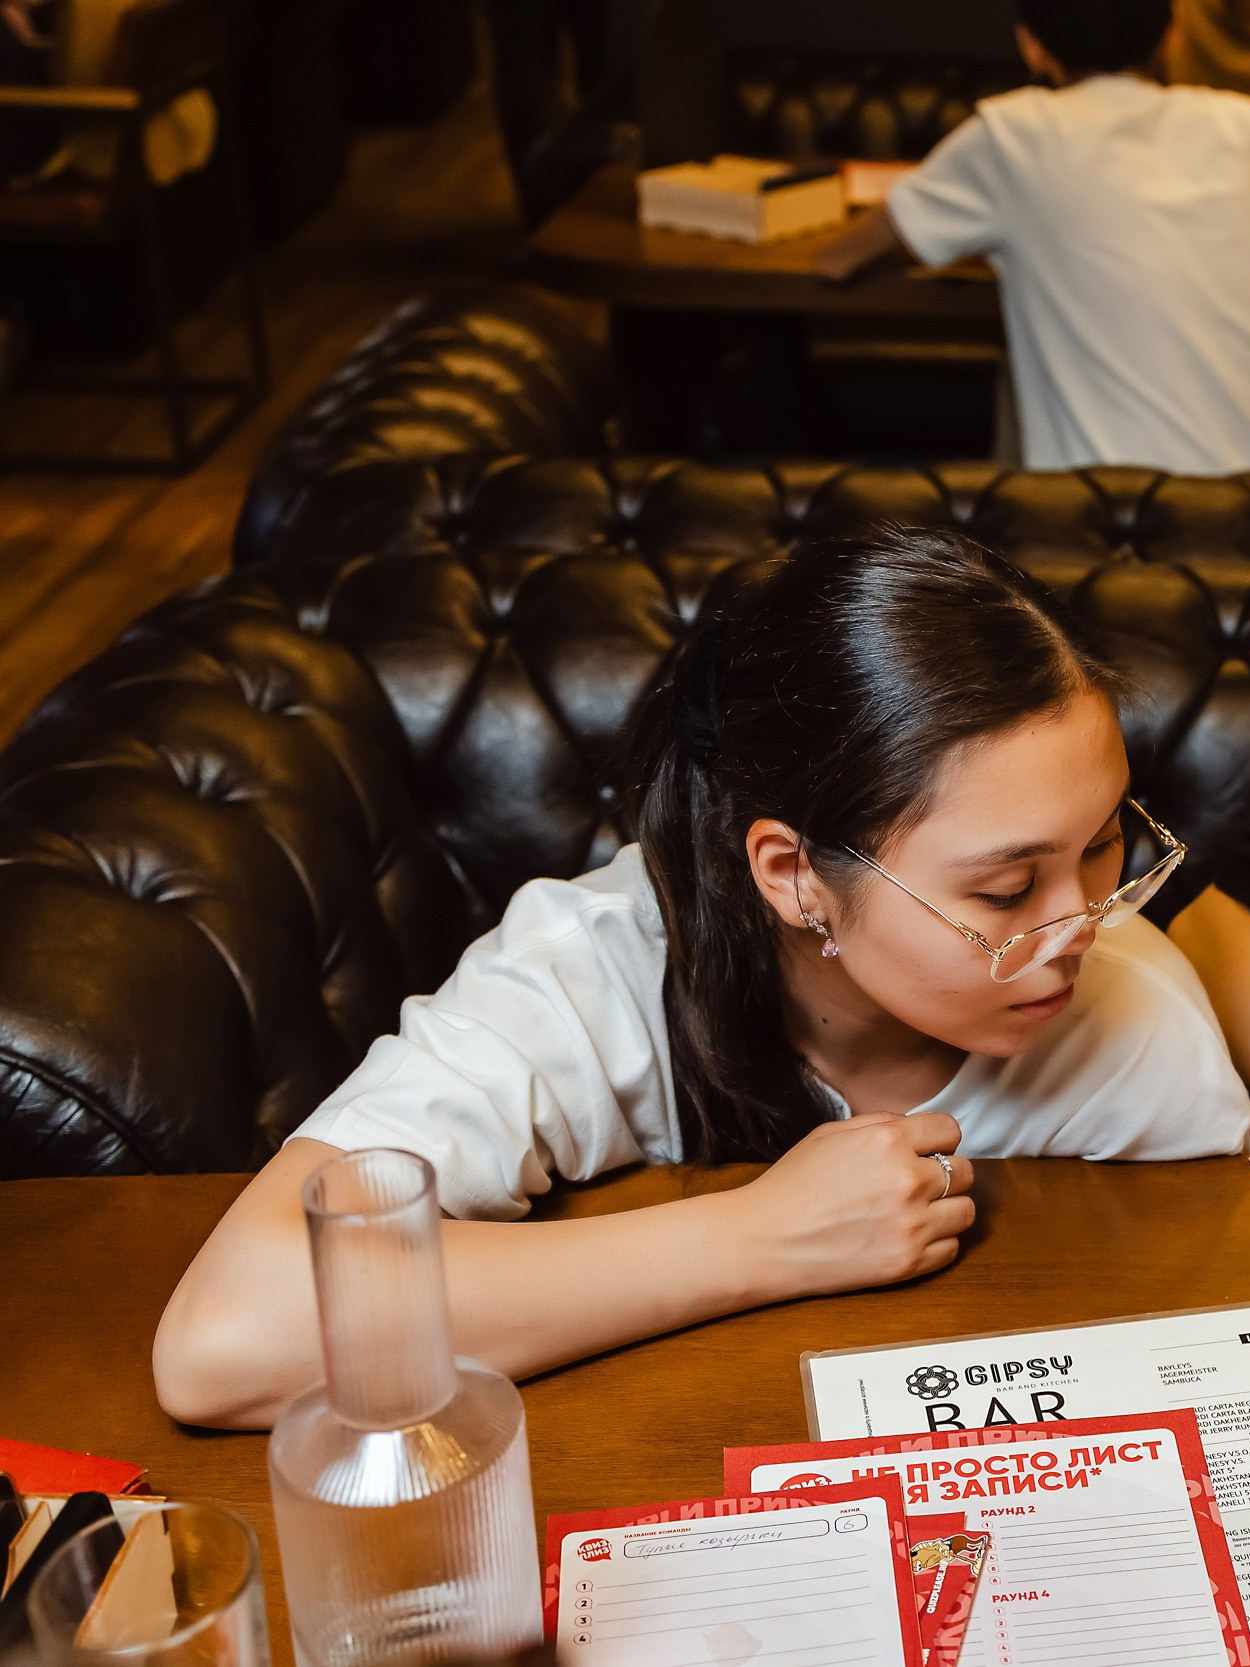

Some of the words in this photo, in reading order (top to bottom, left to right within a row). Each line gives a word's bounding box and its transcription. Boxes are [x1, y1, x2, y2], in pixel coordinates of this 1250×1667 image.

[964, 1354, 1073, 1386] GIPSY
[1157, 1362, 1192, 1371] BAYLEYS
[1159, 1366, 1217, 1379] JAGERMEISTER
[996, 1385, 1014, 1394] BAR
[1018, 1382, 1037, 1391] AND
[1040, 1378, 1080, 1389] KITCHEN
[1162, 1375, 1201, 1386] SAMBUCA
[925, 1391, 1067, 1433] BAR
[1207, 1402, 1234, 1411] CARTA
[1209, 1409, 1236, 1418] CARTA
[1208, 1425, 1234, 1434] JERRY
[906, 1452, 1058, 1483] ПРОСТО
[1068, 1440, 1162, 1468] ЛИСТ
[980, 1506, 1024, 1518] РАУНД
[1027, 1505, 1036, 1514] 2
[843, 1519, 854, 1530] 6
[624, 1531, 657, 1539] НАЗВАНИЕ
[658, 1527, 692, 1536] КОМАНДЫ
[992, 1591, 1039, 1603] РАУНД
[1041, 1590, 1050, 1598] 4
